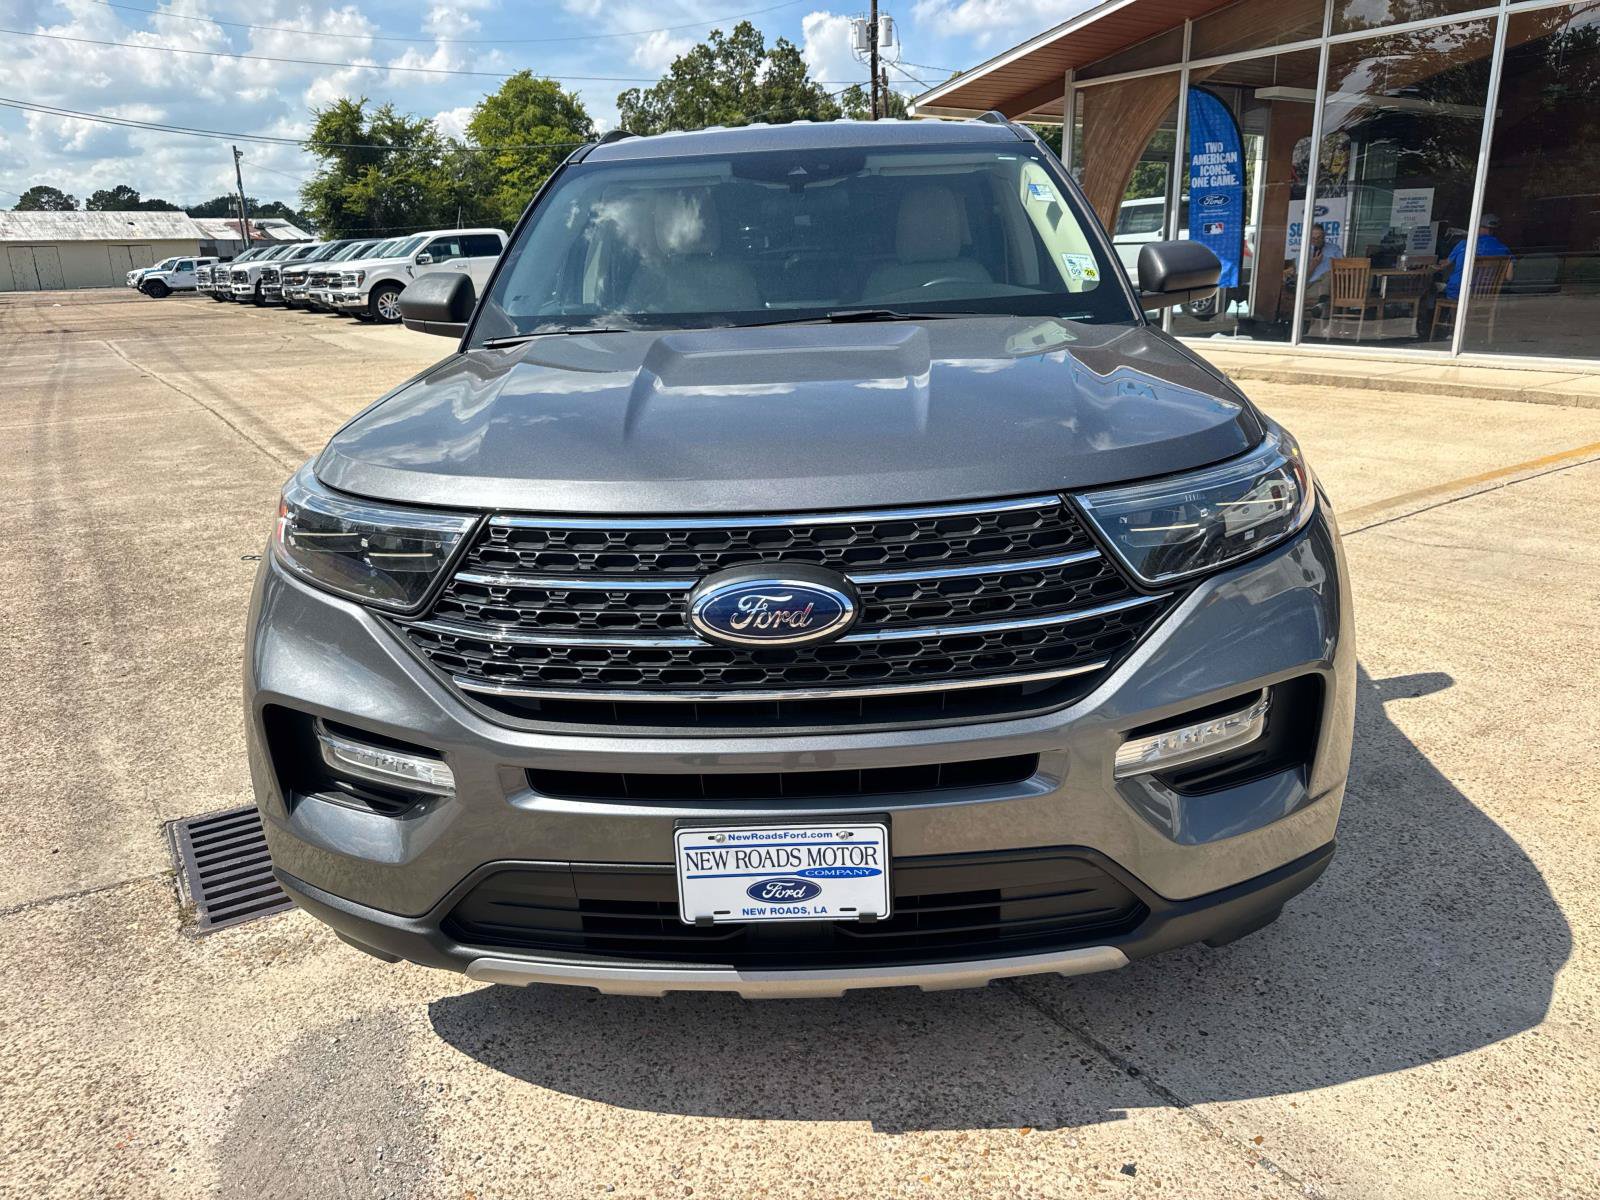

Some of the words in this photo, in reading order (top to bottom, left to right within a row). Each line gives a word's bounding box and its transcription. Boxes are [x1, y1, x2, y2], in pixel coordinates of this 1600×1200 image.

[1204, 142, 1224, 154] TWO
[1192, 152, 1238, 166] AMERICAN
[1200, 165, 1230, 177] ICONS.
[1191, 176, 1209, 188] ONE
[1210, 175, 1240, 187] GAME.
[1203, 196, 1224, 206] Ford
[1289, 221, 1341, 237] SUER
[729, 594, 815, 630] Ford
[727, 831, 833, 842] NewRoadsFord.com
[685, 850, 730, 872] NEW
[735, 848, 802, 869] ROADS
[807, 846, 878, 867] MOTOR
[805, 869, 872, 877] COMPANY
[762, 881, 807, 900] Ford
[742, 907, 766, 916] NEW
[770, 906, 810, 915] ROADS,
[814, 906, 827, 914] LA
